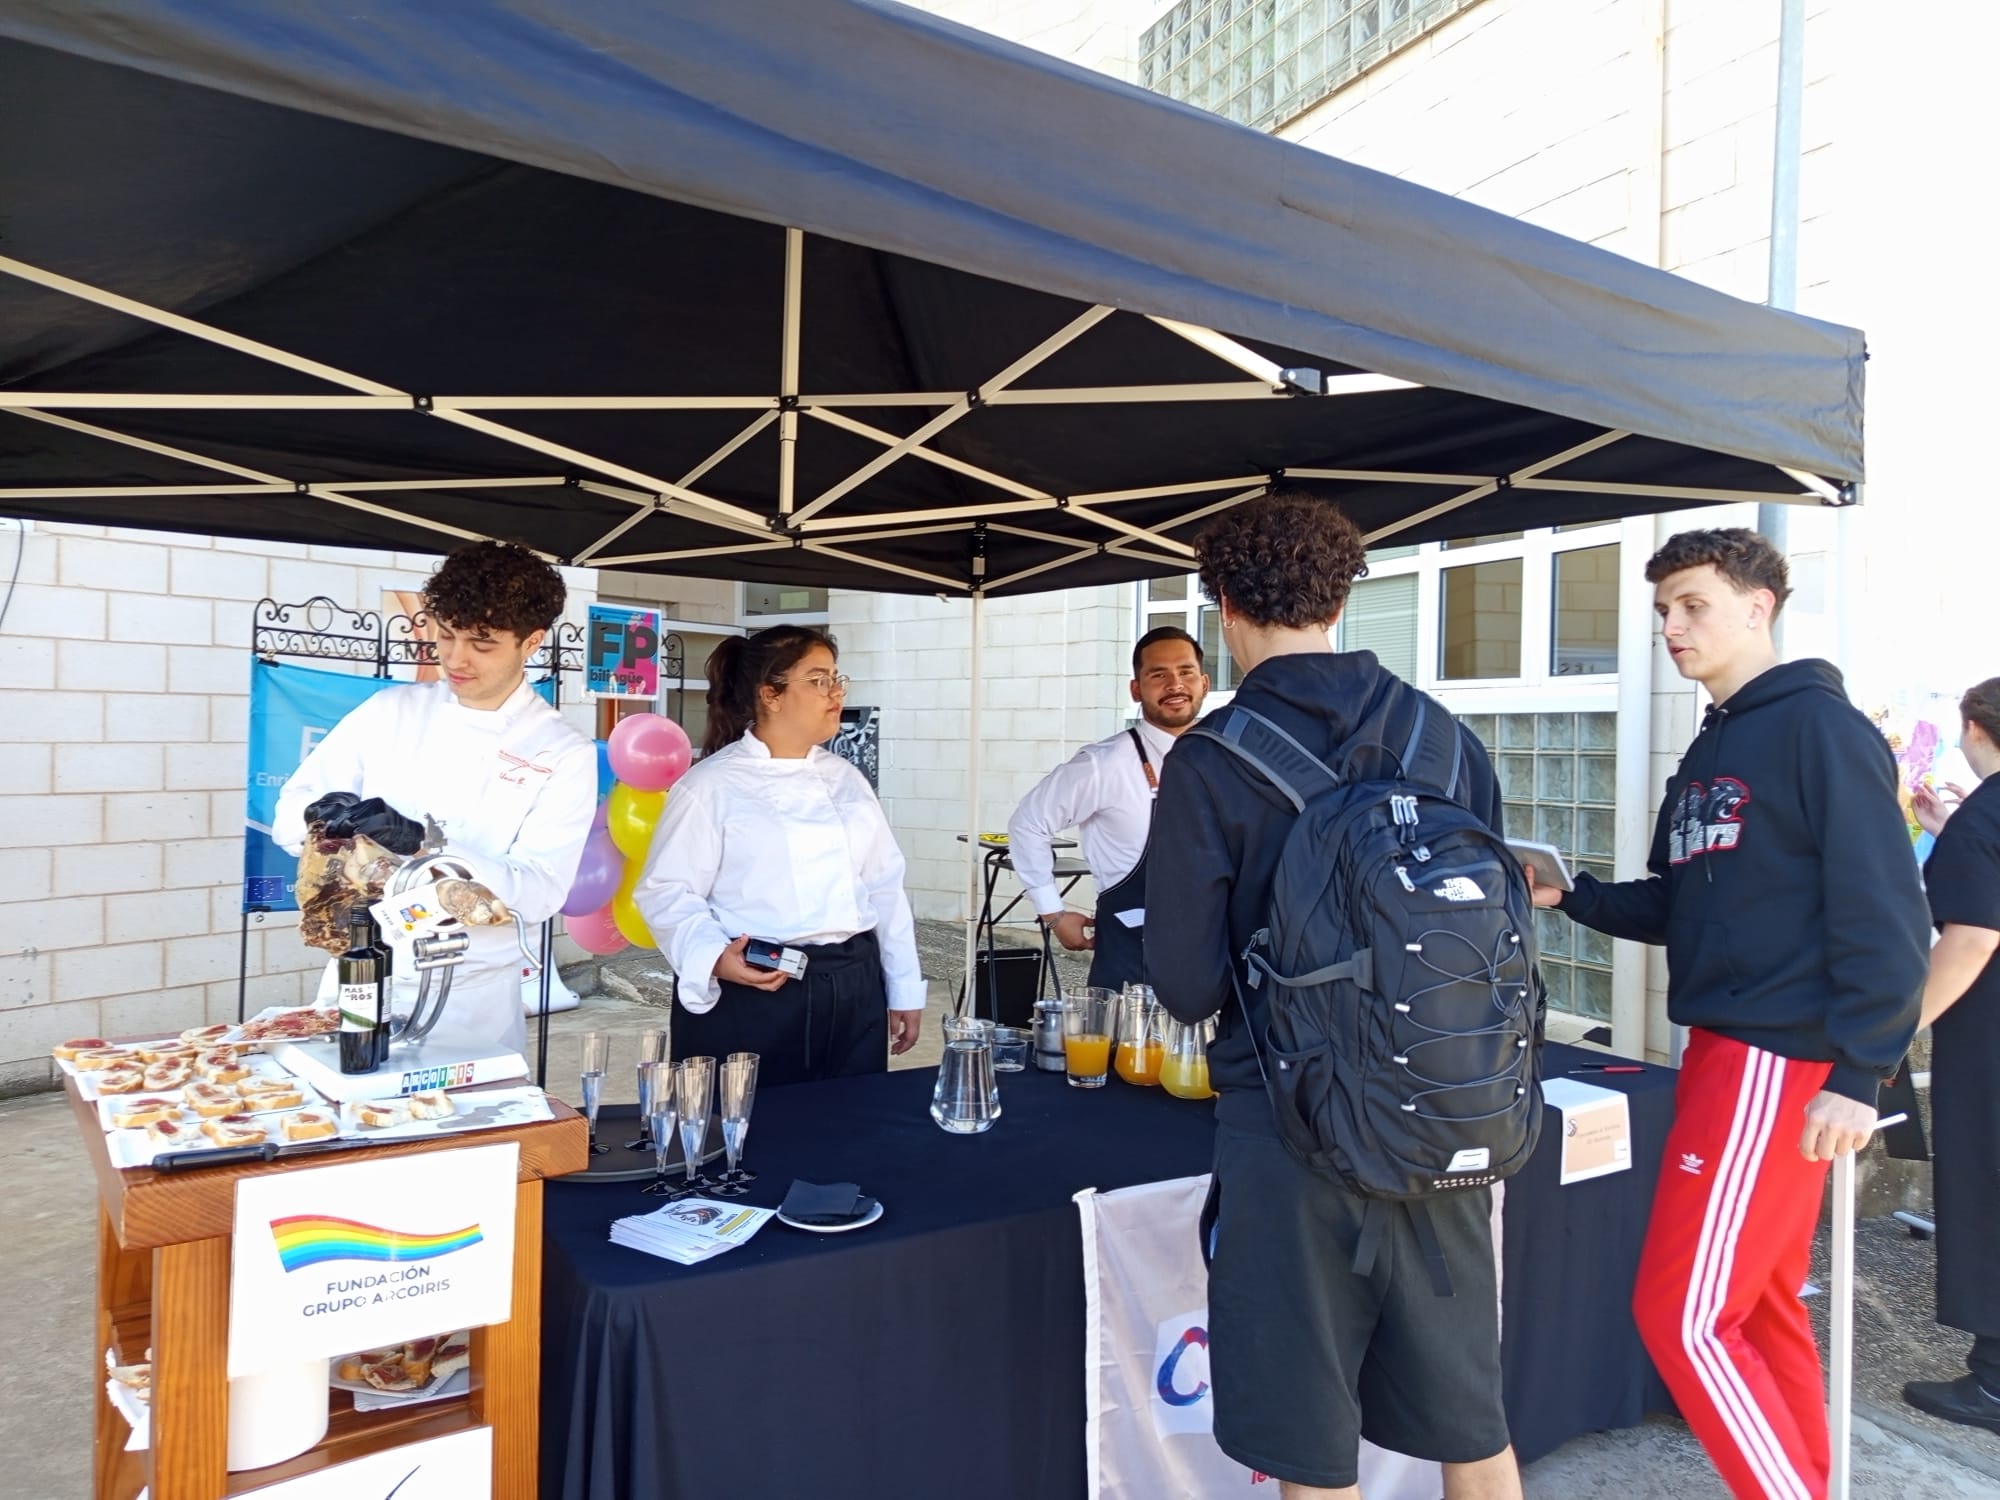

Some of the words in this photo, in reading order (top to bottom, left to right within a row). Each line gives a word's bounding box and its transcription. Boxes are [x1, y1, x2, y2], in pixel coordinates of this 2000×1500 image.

[591, 621, 658, 669] FP
[402, 1064, 474, 1091] ARCOIRIS
[327, 1265, 430, 1294] FUNDACIÓN
[303, 1296, 367, 1317] GRUPO
